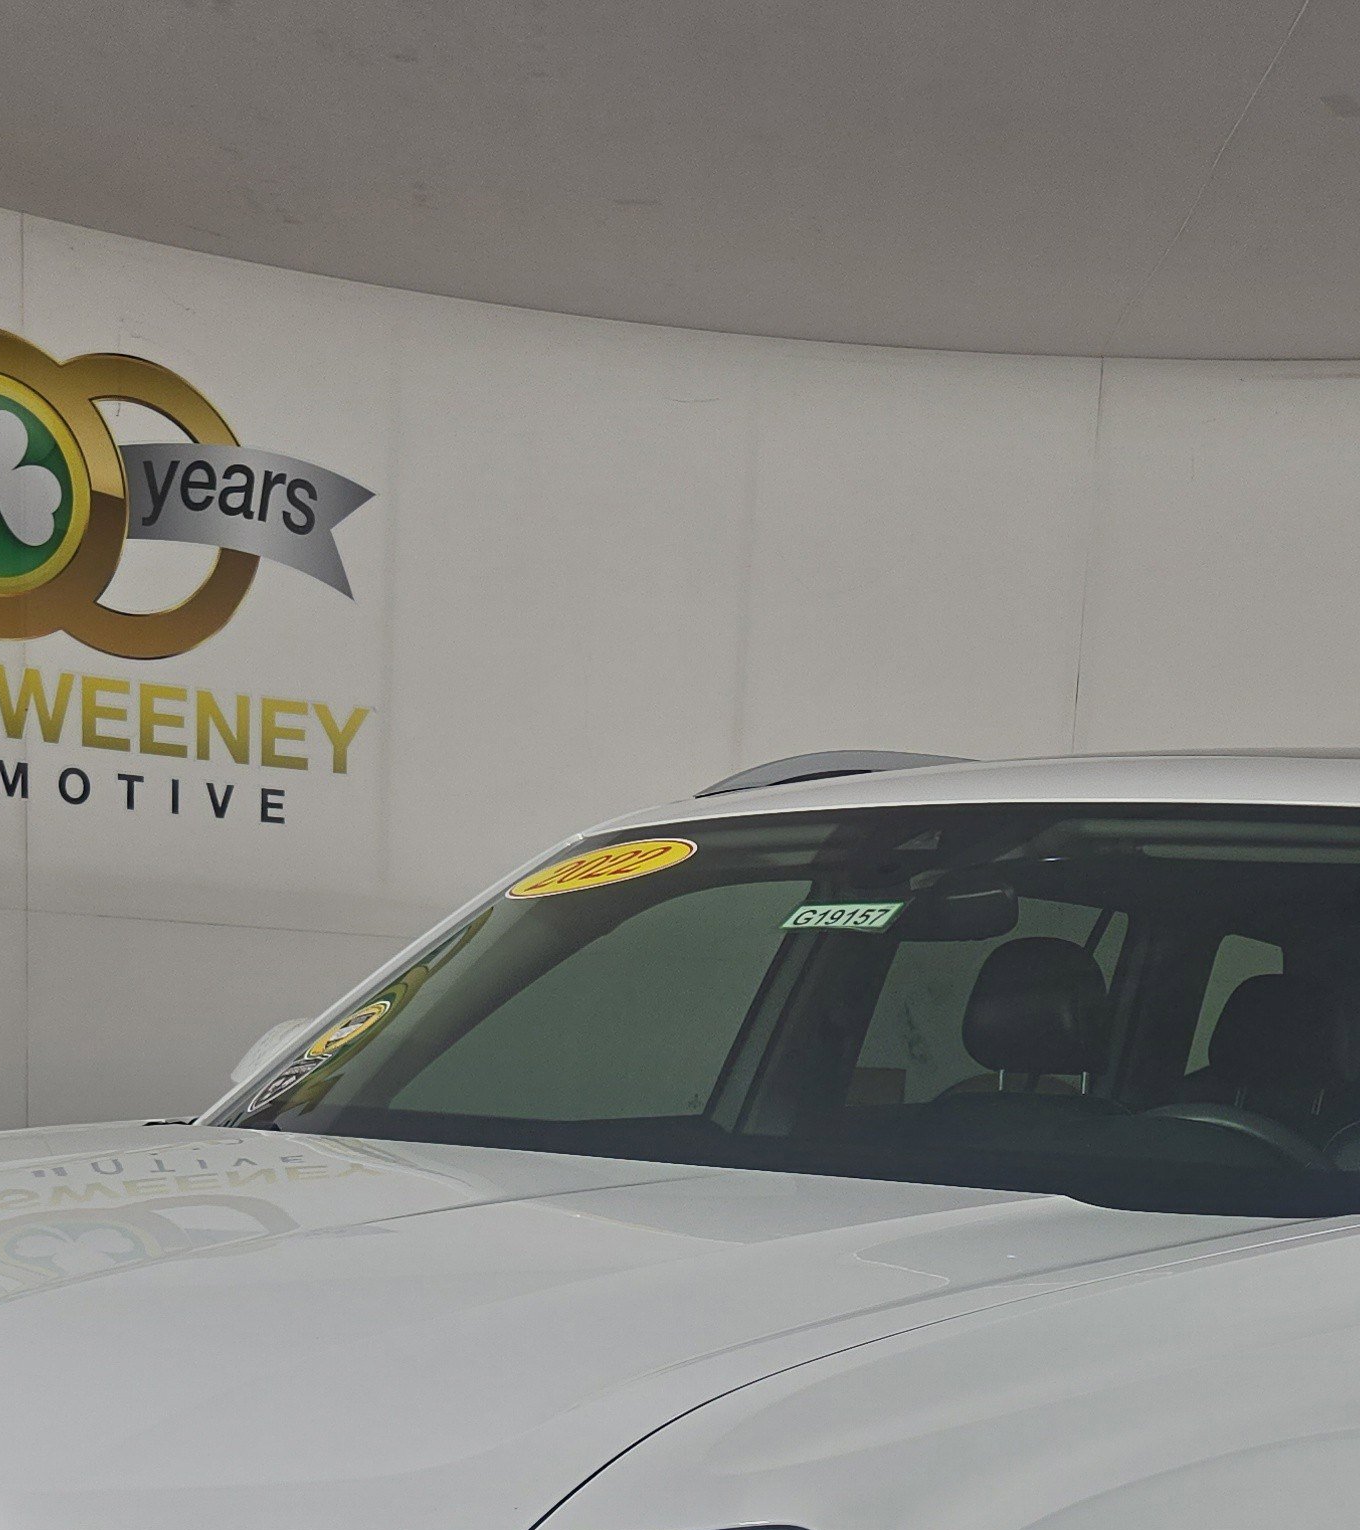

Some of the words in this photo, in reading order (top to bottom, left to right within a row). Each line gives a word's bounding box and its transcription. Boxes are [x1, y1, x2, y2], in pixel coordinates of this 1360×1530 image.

[140, 456, 319, 537] years
[524, 845, 673, 892] 2022
[793, 908, 889, 927] G19157
